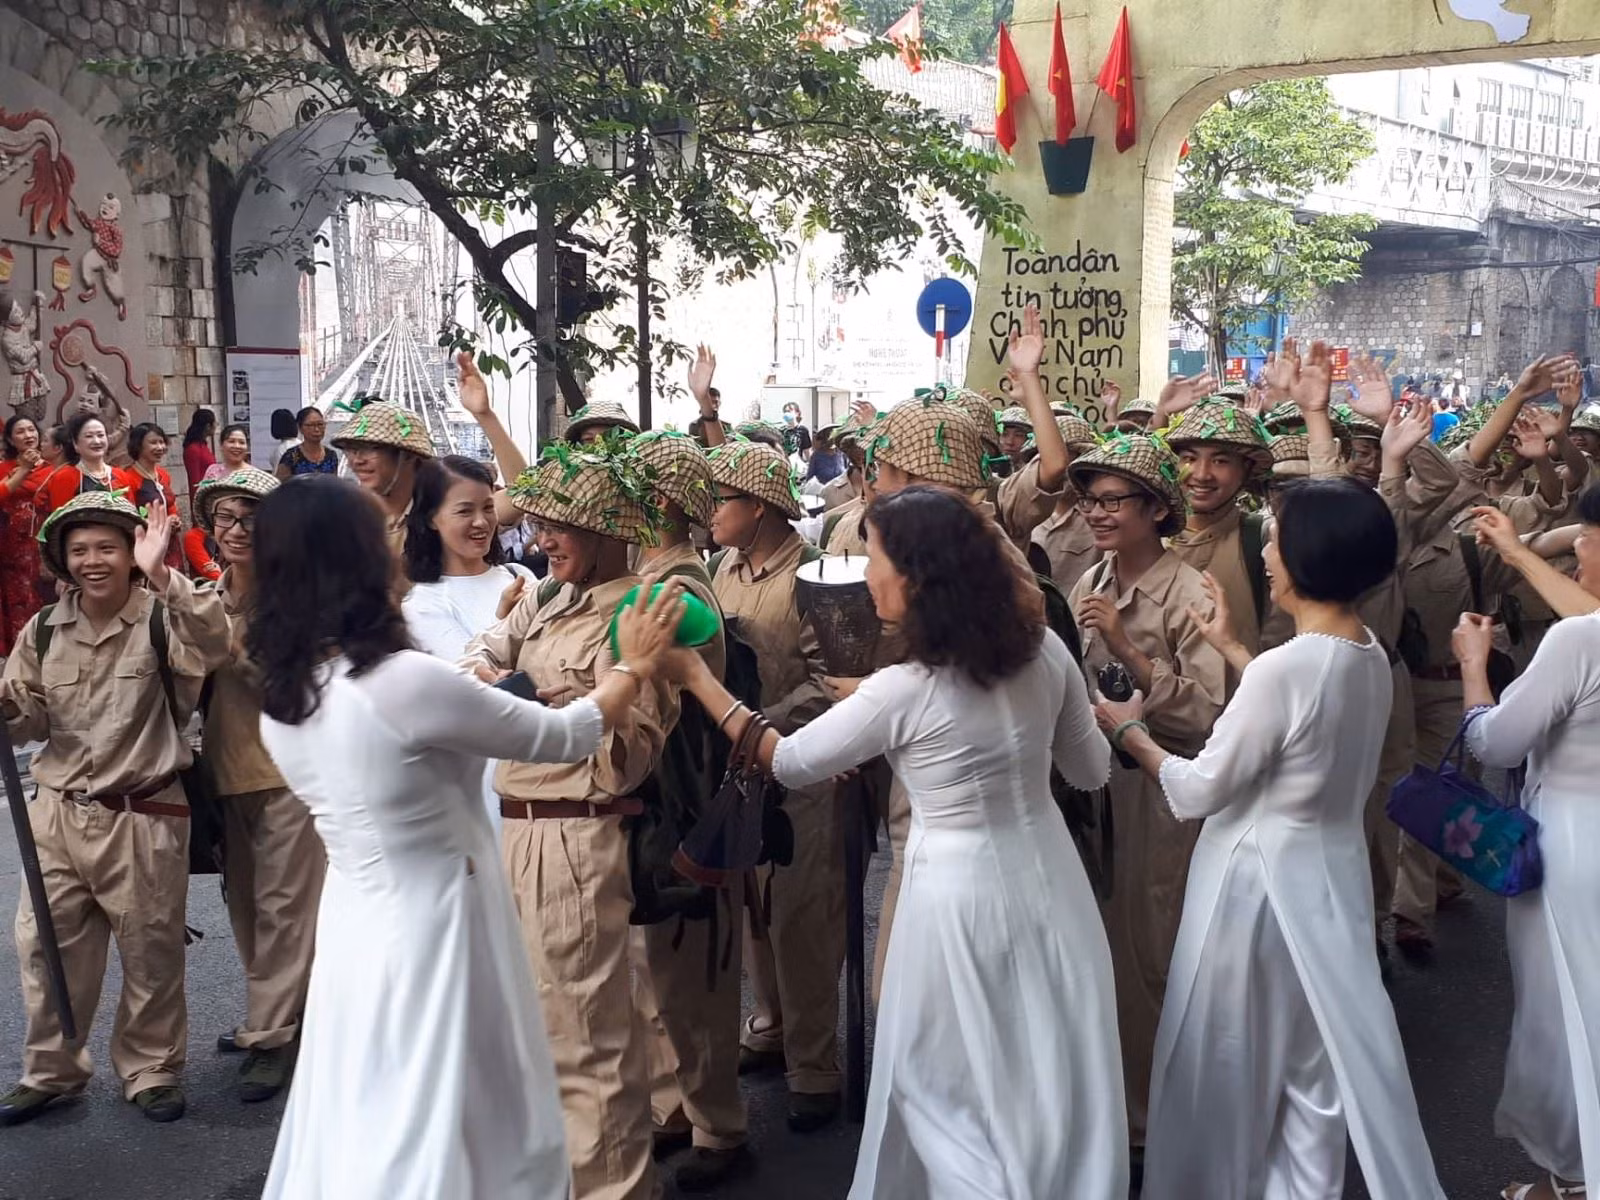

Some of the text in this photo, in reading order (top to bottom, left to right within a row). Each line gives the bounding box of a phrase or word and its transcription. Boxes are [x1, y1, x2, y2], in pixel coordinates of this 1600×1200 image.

[1001, 277, 1122, 318] tin tưởng
[990, 306, 1128, 347] Chnh phủ
[1056, 338, 1123, 368] Nam
[1056, 366, 1104, 398] chủ
